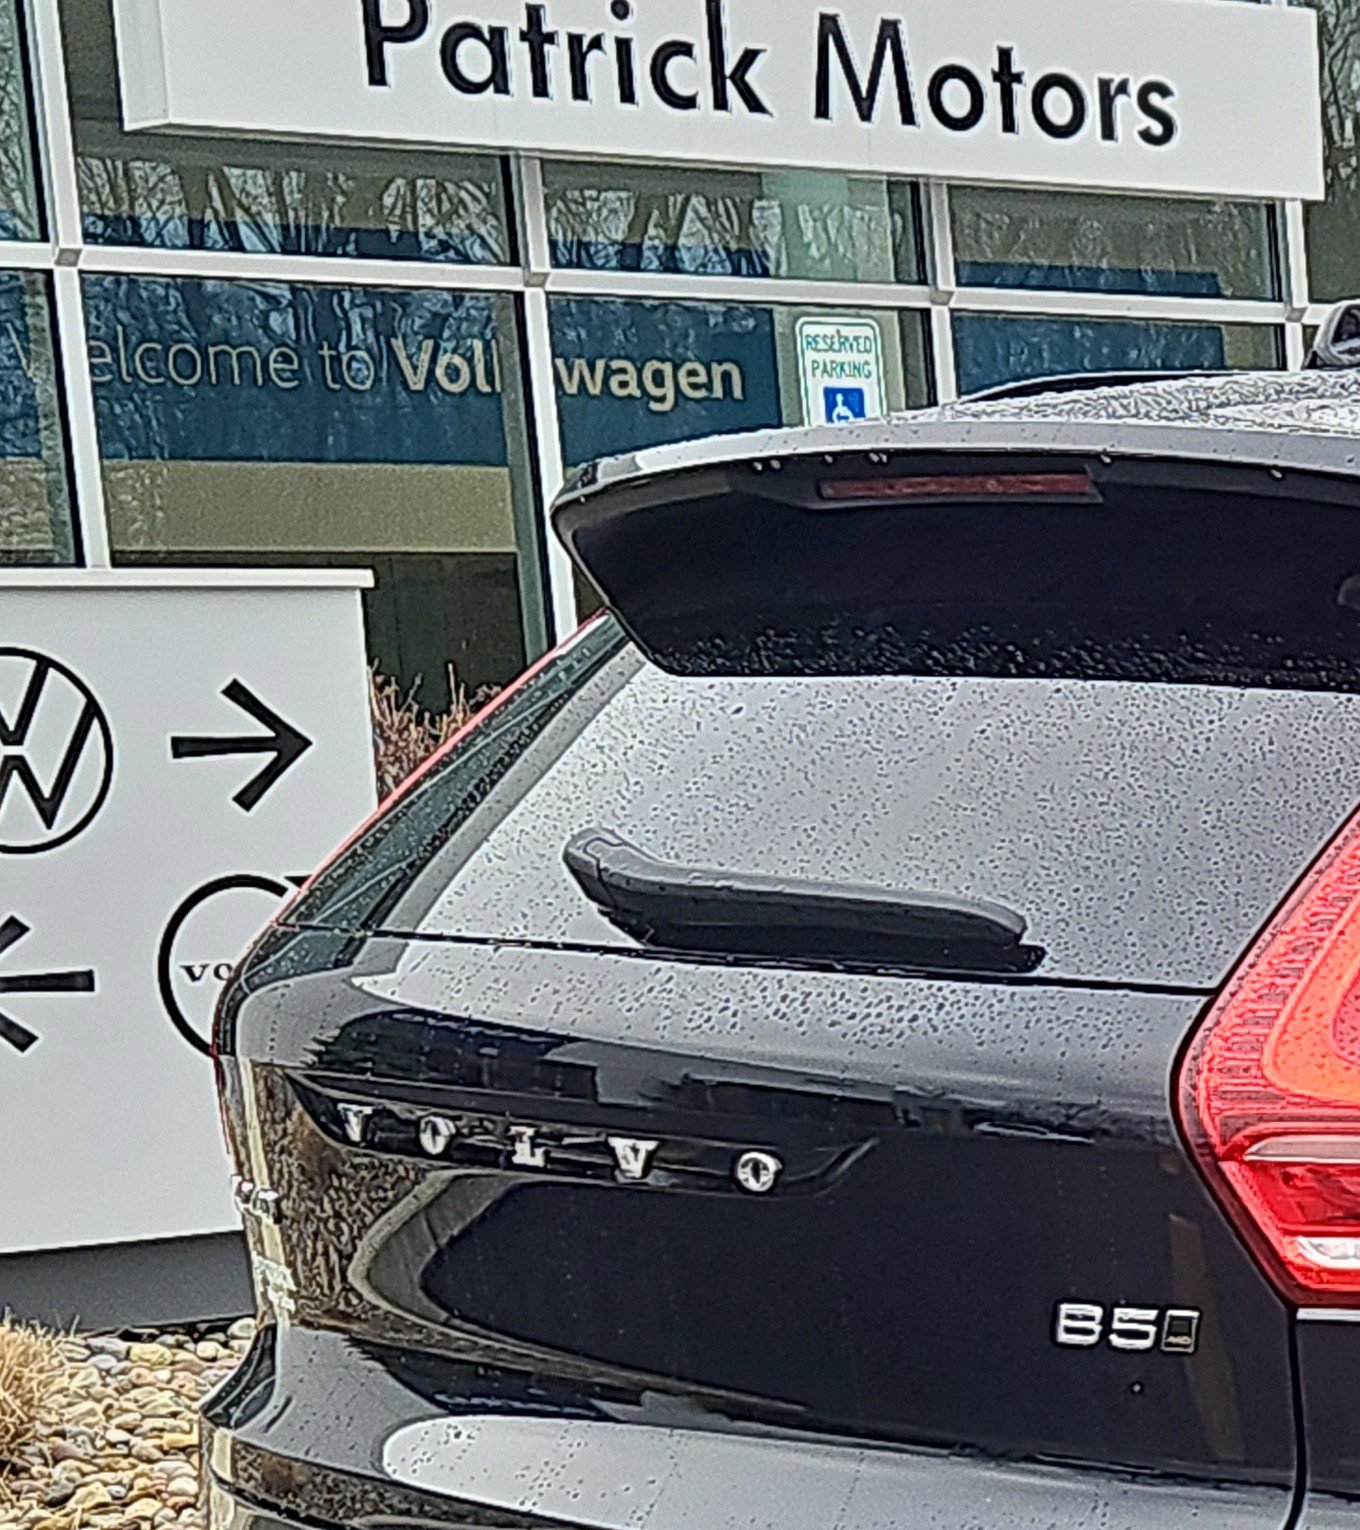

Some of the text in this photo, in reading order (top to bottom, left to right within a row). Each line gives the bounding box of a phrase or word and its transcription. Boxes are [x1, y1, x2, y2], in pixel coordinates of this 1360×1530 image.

[363, 0, 1178, 147] Patrick Motors
[804, 333, 873, 354] RESERVED
[811, 359, 873, 379] PARKING
[318, 340, 376, 391] to
[389, 337, 745, 413] Volwagen
[336, 1102, 784, 1193] VOLVO
[1056, 1303, 1160, 1350] B5
